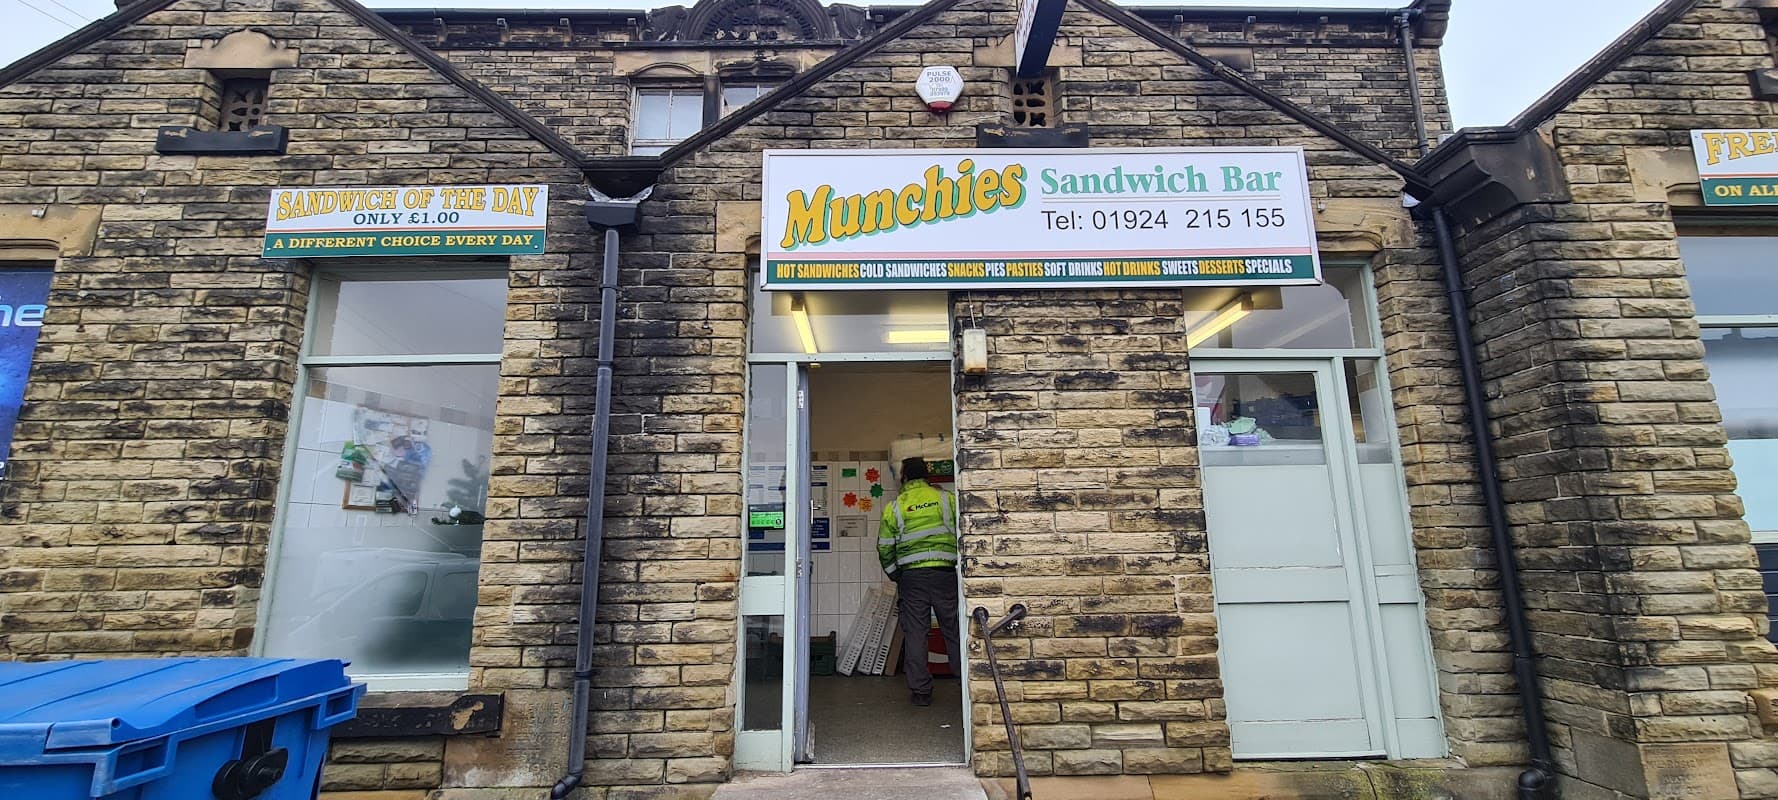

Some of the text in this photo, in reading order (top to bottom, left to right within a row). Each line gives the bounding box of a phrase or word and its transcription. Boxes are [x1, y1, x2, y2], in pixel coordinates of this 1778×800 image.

[1040, 165, 1282, 195] Sandwich Bar
[1714, 185, 1742, 197] ON
[276, 187, 539, 221] SANDWICH OF THE DAY
[780, 159, 1027, 251] Munchies
[353, 211, 459, 225] ONLY £1.00
[1041, 208, 1285, 231] Tel: 01924 215 155
[272, 235, 534, 249] A DIFFERENT CHOICE EVERY DAY
[776, 259, 1293, 278] HOT SANDWICHES COLD SANDWICHES SNACKS PIES PASTIES SOFT DRINKS HOT DRINKS SWEETS DESSERTS SPECIALS
